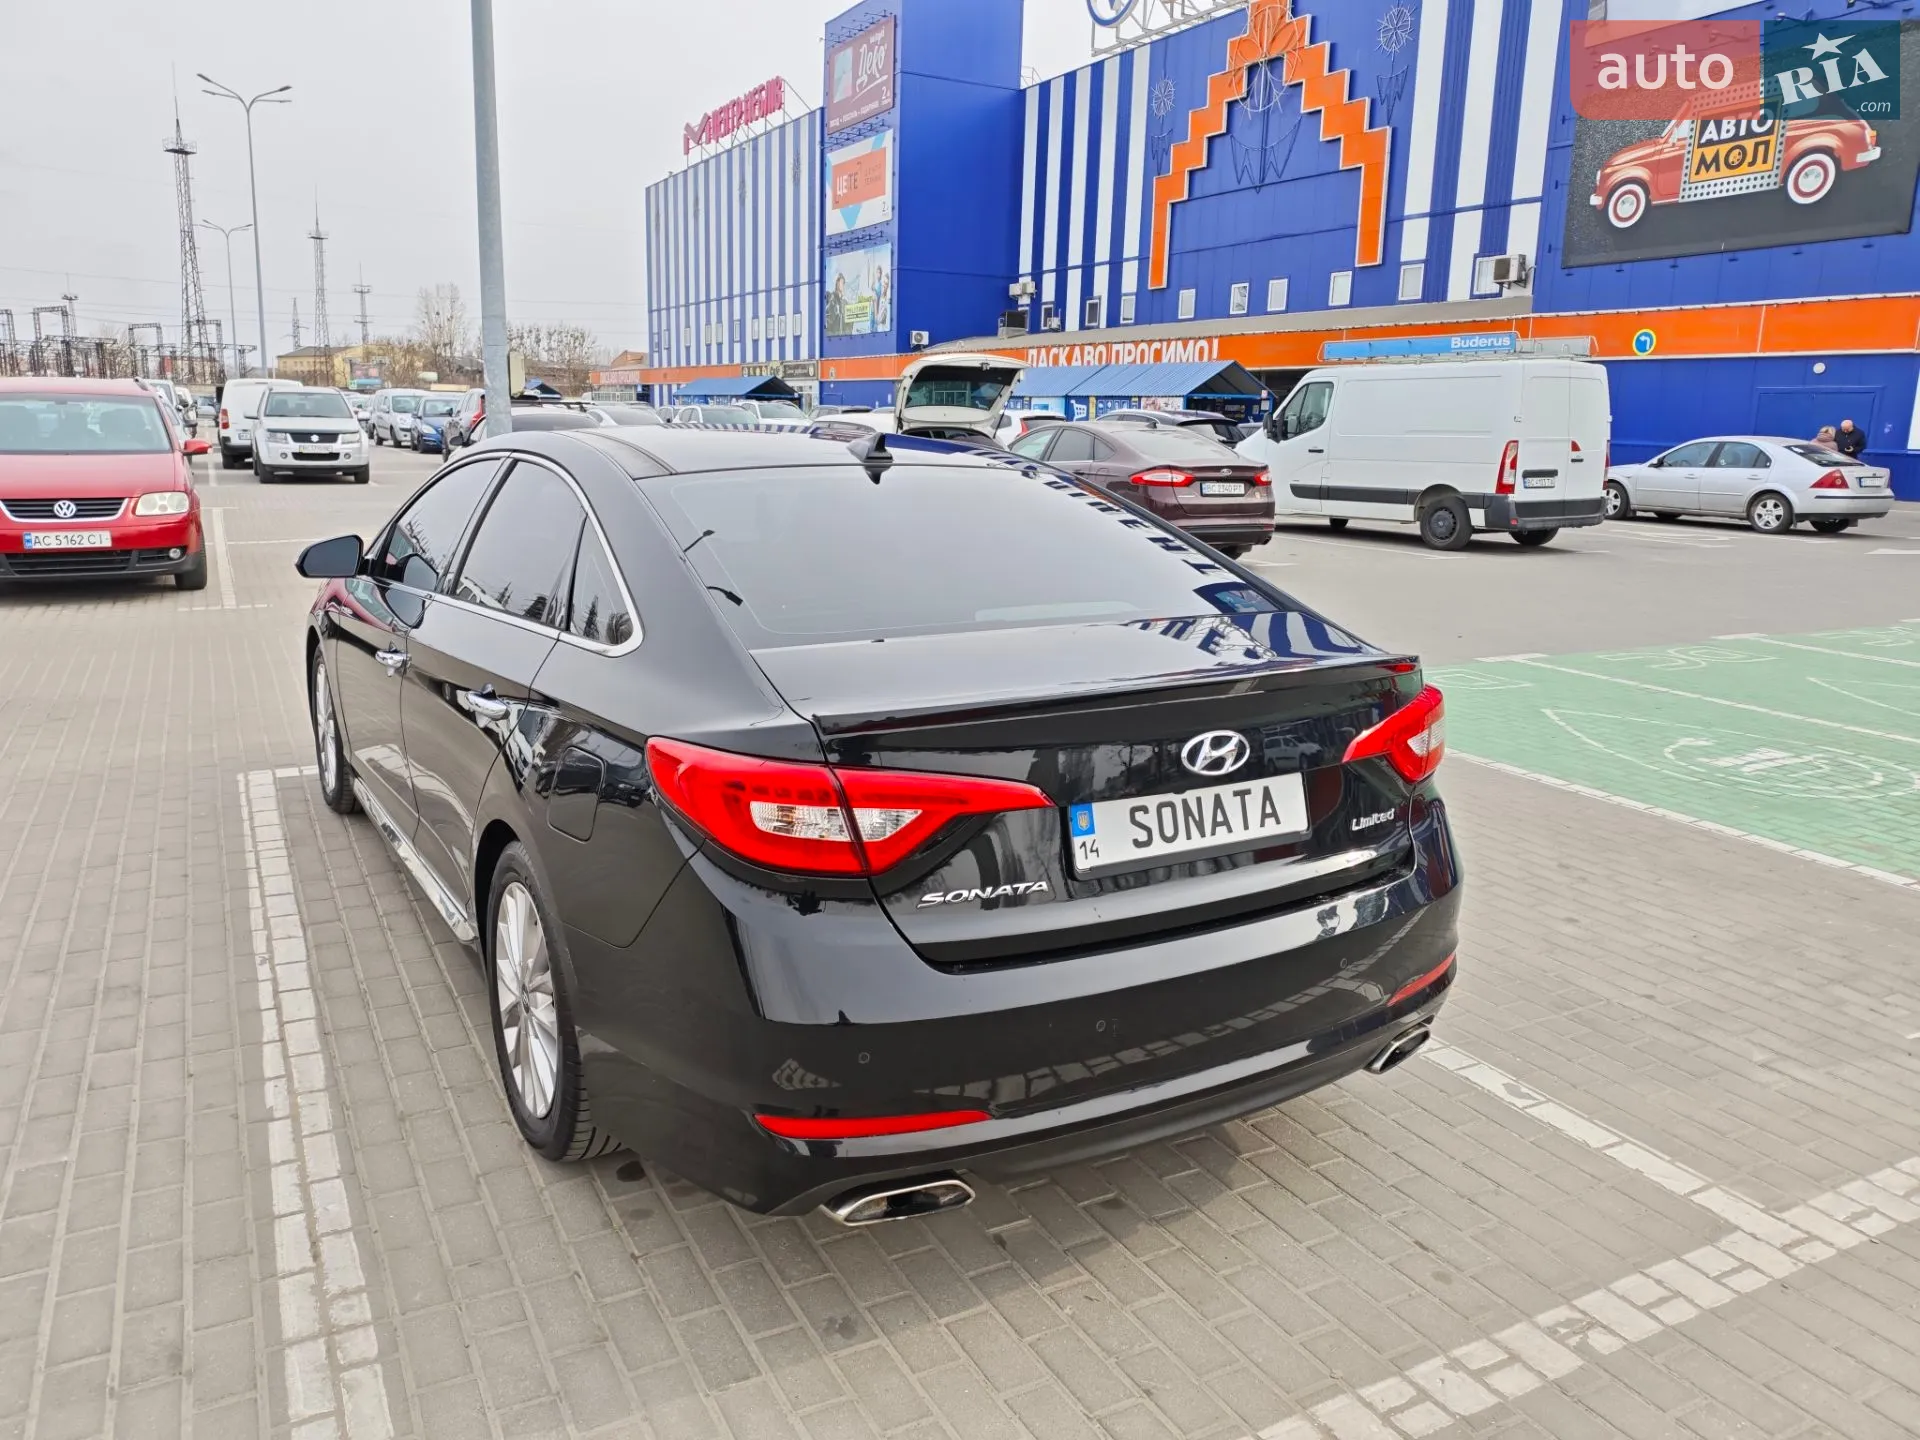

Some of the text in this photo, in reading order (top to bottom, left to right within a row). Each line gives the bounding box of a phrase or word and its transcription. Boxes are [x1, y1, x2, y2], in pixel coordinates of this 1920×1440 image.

[1700, 108, 1775, 144] АВТО
[1694, 139, 1771, 176] МОЛ
[1111, 337, 1219, 365] ПРОСИМО!
[1450, 336, 1511, 349] Buderus
[34, 535, 52, 547] AC
[55, 534, 85, 547] 5162
[1129, 785, 1281, 849] SONATA
[1352, 808, 1395, 831] Limited
[1079, 838, 1100, 860] 14
[917, 881, 1049, 908] SONATA
